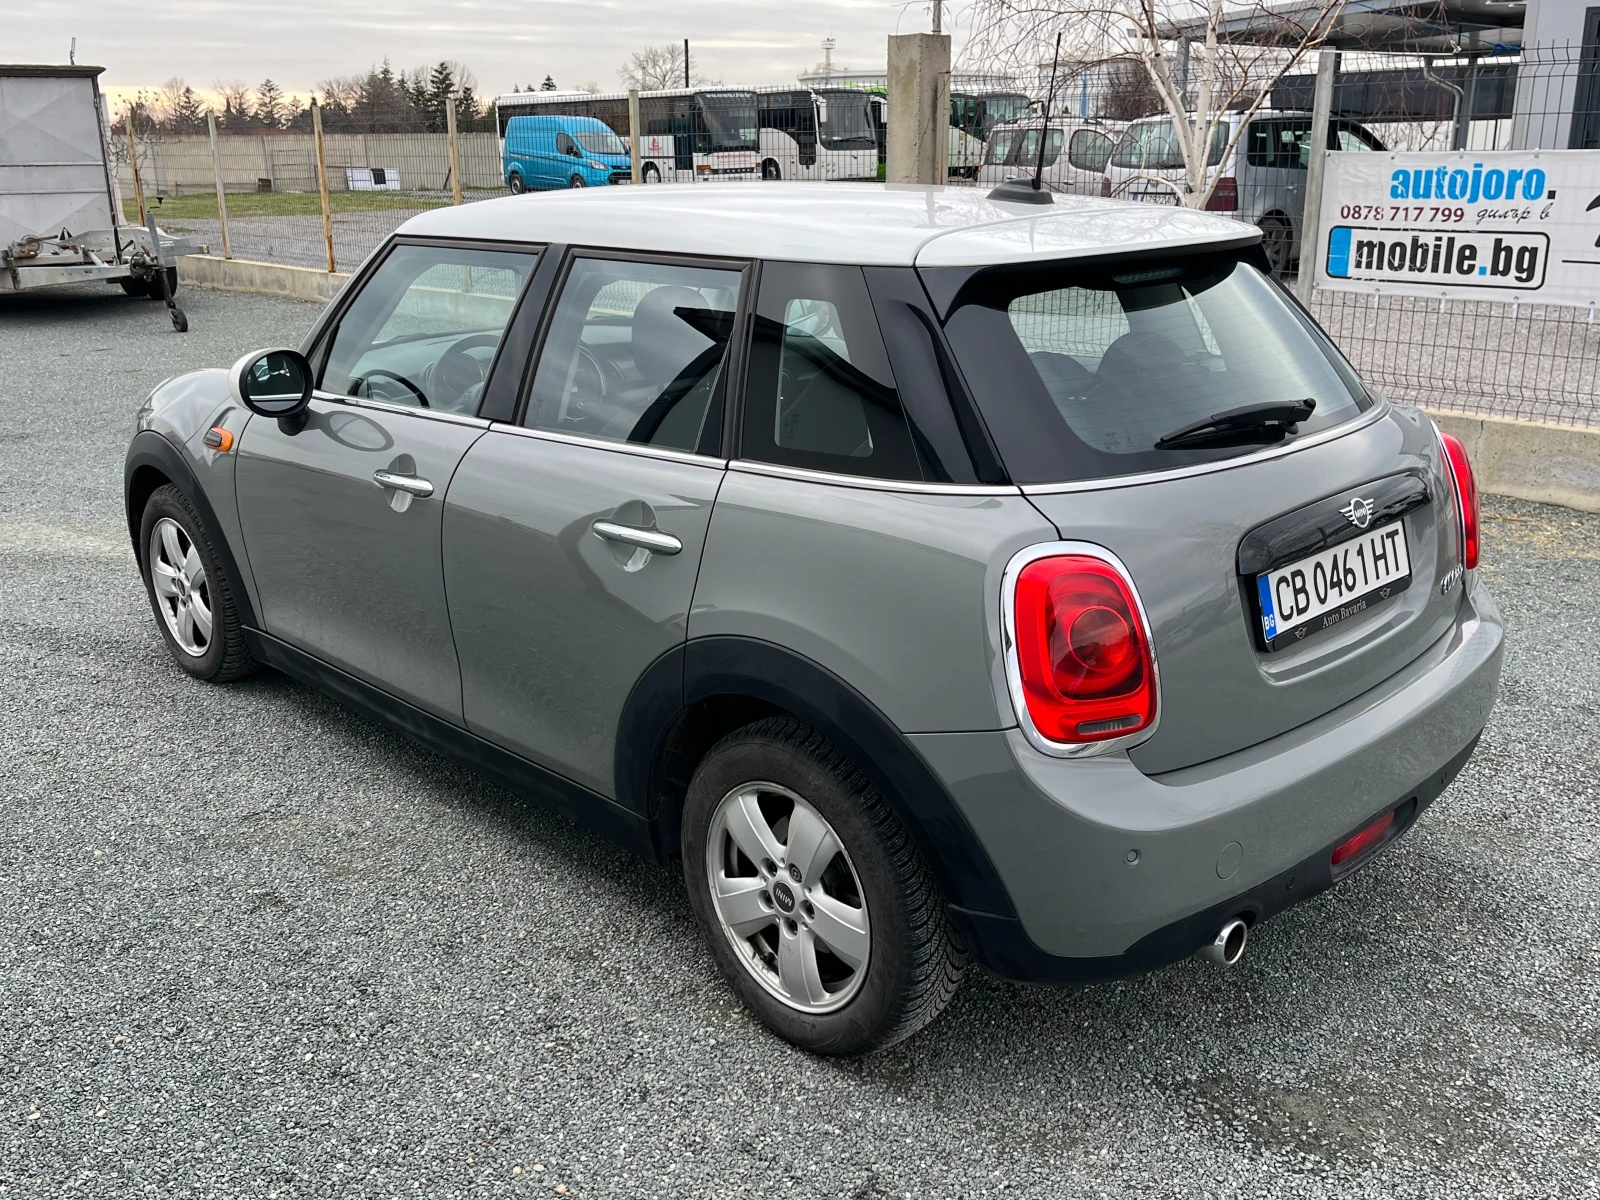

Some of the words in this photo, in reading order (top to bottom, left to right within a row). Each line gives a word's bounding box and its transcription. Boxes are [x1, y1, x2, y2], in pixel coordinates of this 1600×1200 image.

[1389, 163, 1557, 204] autojoro.
[1340, 204, 1384, 221] 0878
[1390, 206, 1424, 222] 717
[1429, 207, 1465, 223] 799
[1354, 236, 1539, 283] mobile.bg
[1313, 542, 1369, 606] 0461
[1264, 613, 1275, 631] BG
[1322, 612, 1340, 629] Auto
[1340, 599, 1367, 620] Bavaria
[775, 887, 793, 907] MINI
